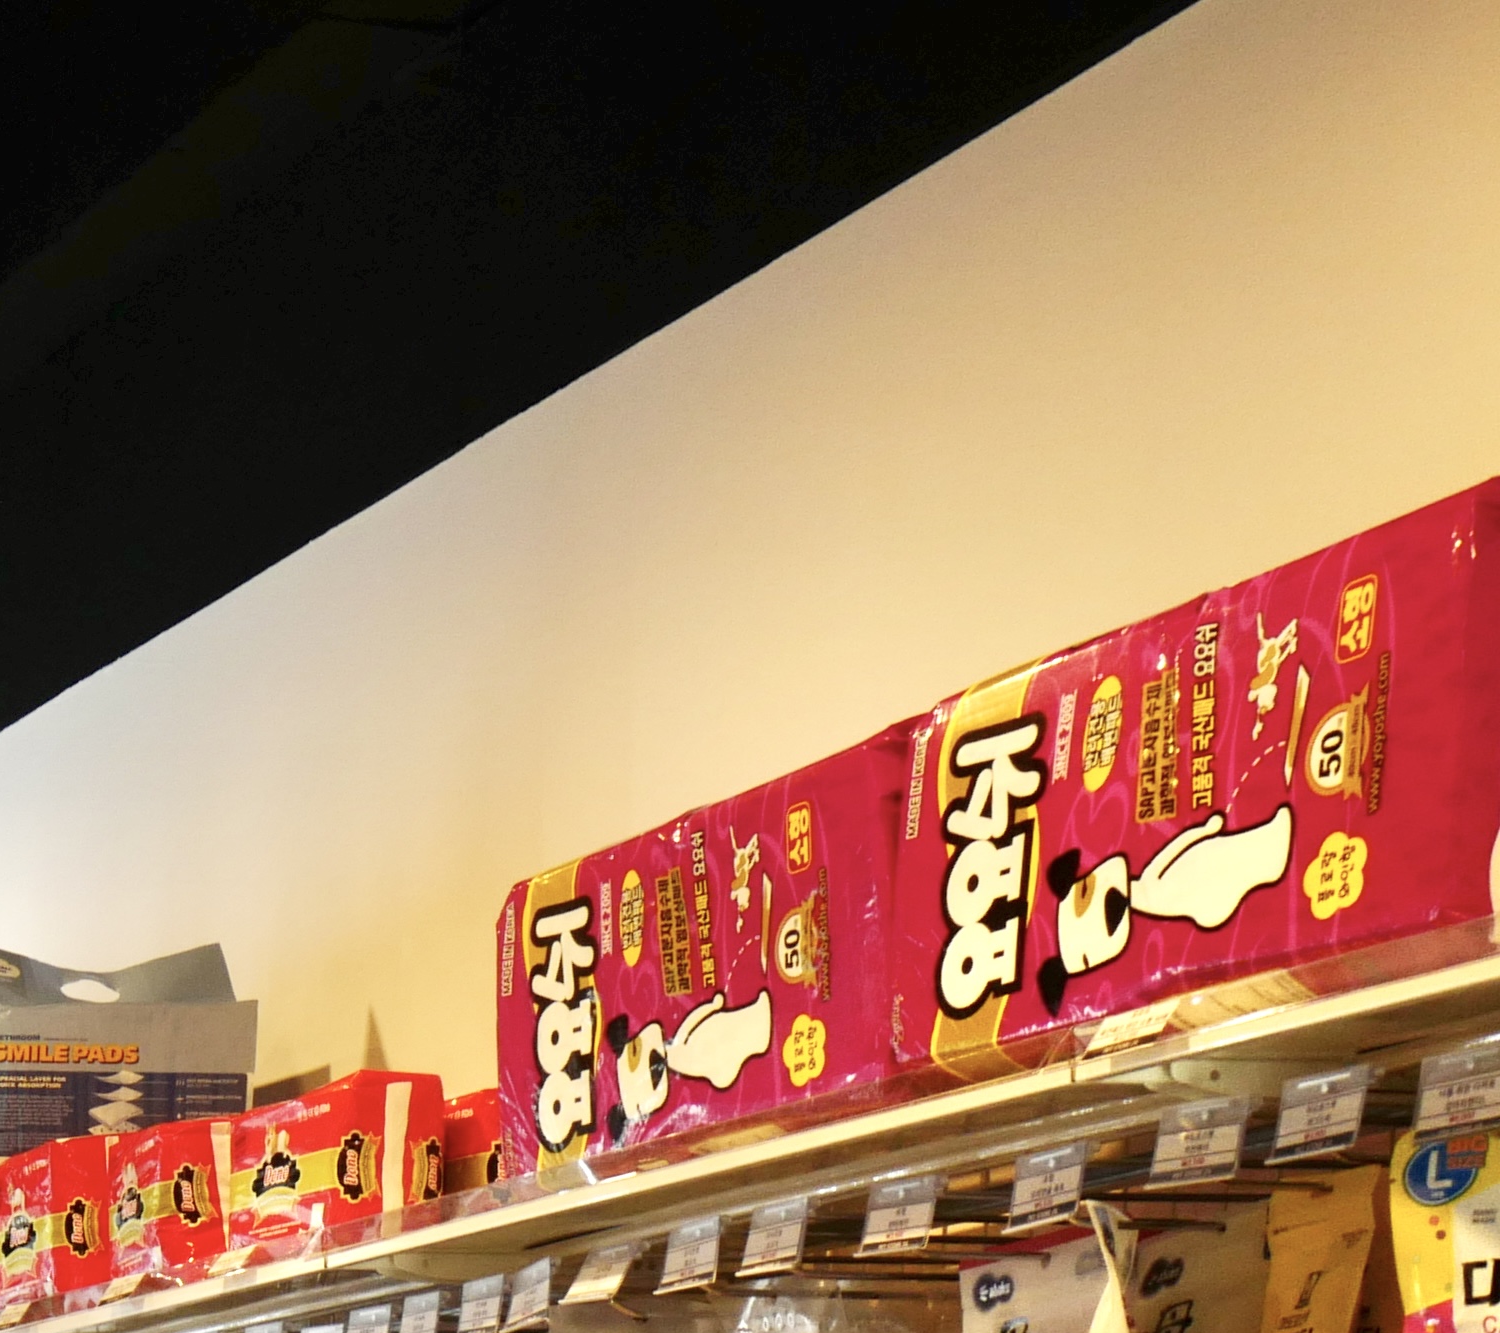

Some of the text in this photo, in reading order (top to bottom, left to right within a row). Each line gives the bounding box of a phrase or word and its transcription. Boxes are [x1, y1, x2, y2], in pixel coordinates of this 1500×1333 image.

[1342, 584, 1375, 653] 소형
[1191, 757, 1213, 808] 고품격
[1319, 731, 1343, 775] 50
[940, 714, 1046, 1019] 요요쉬
[72, 1044, 140, 1065] PADS
[536, 897, 596, 1152] 요요쉬
